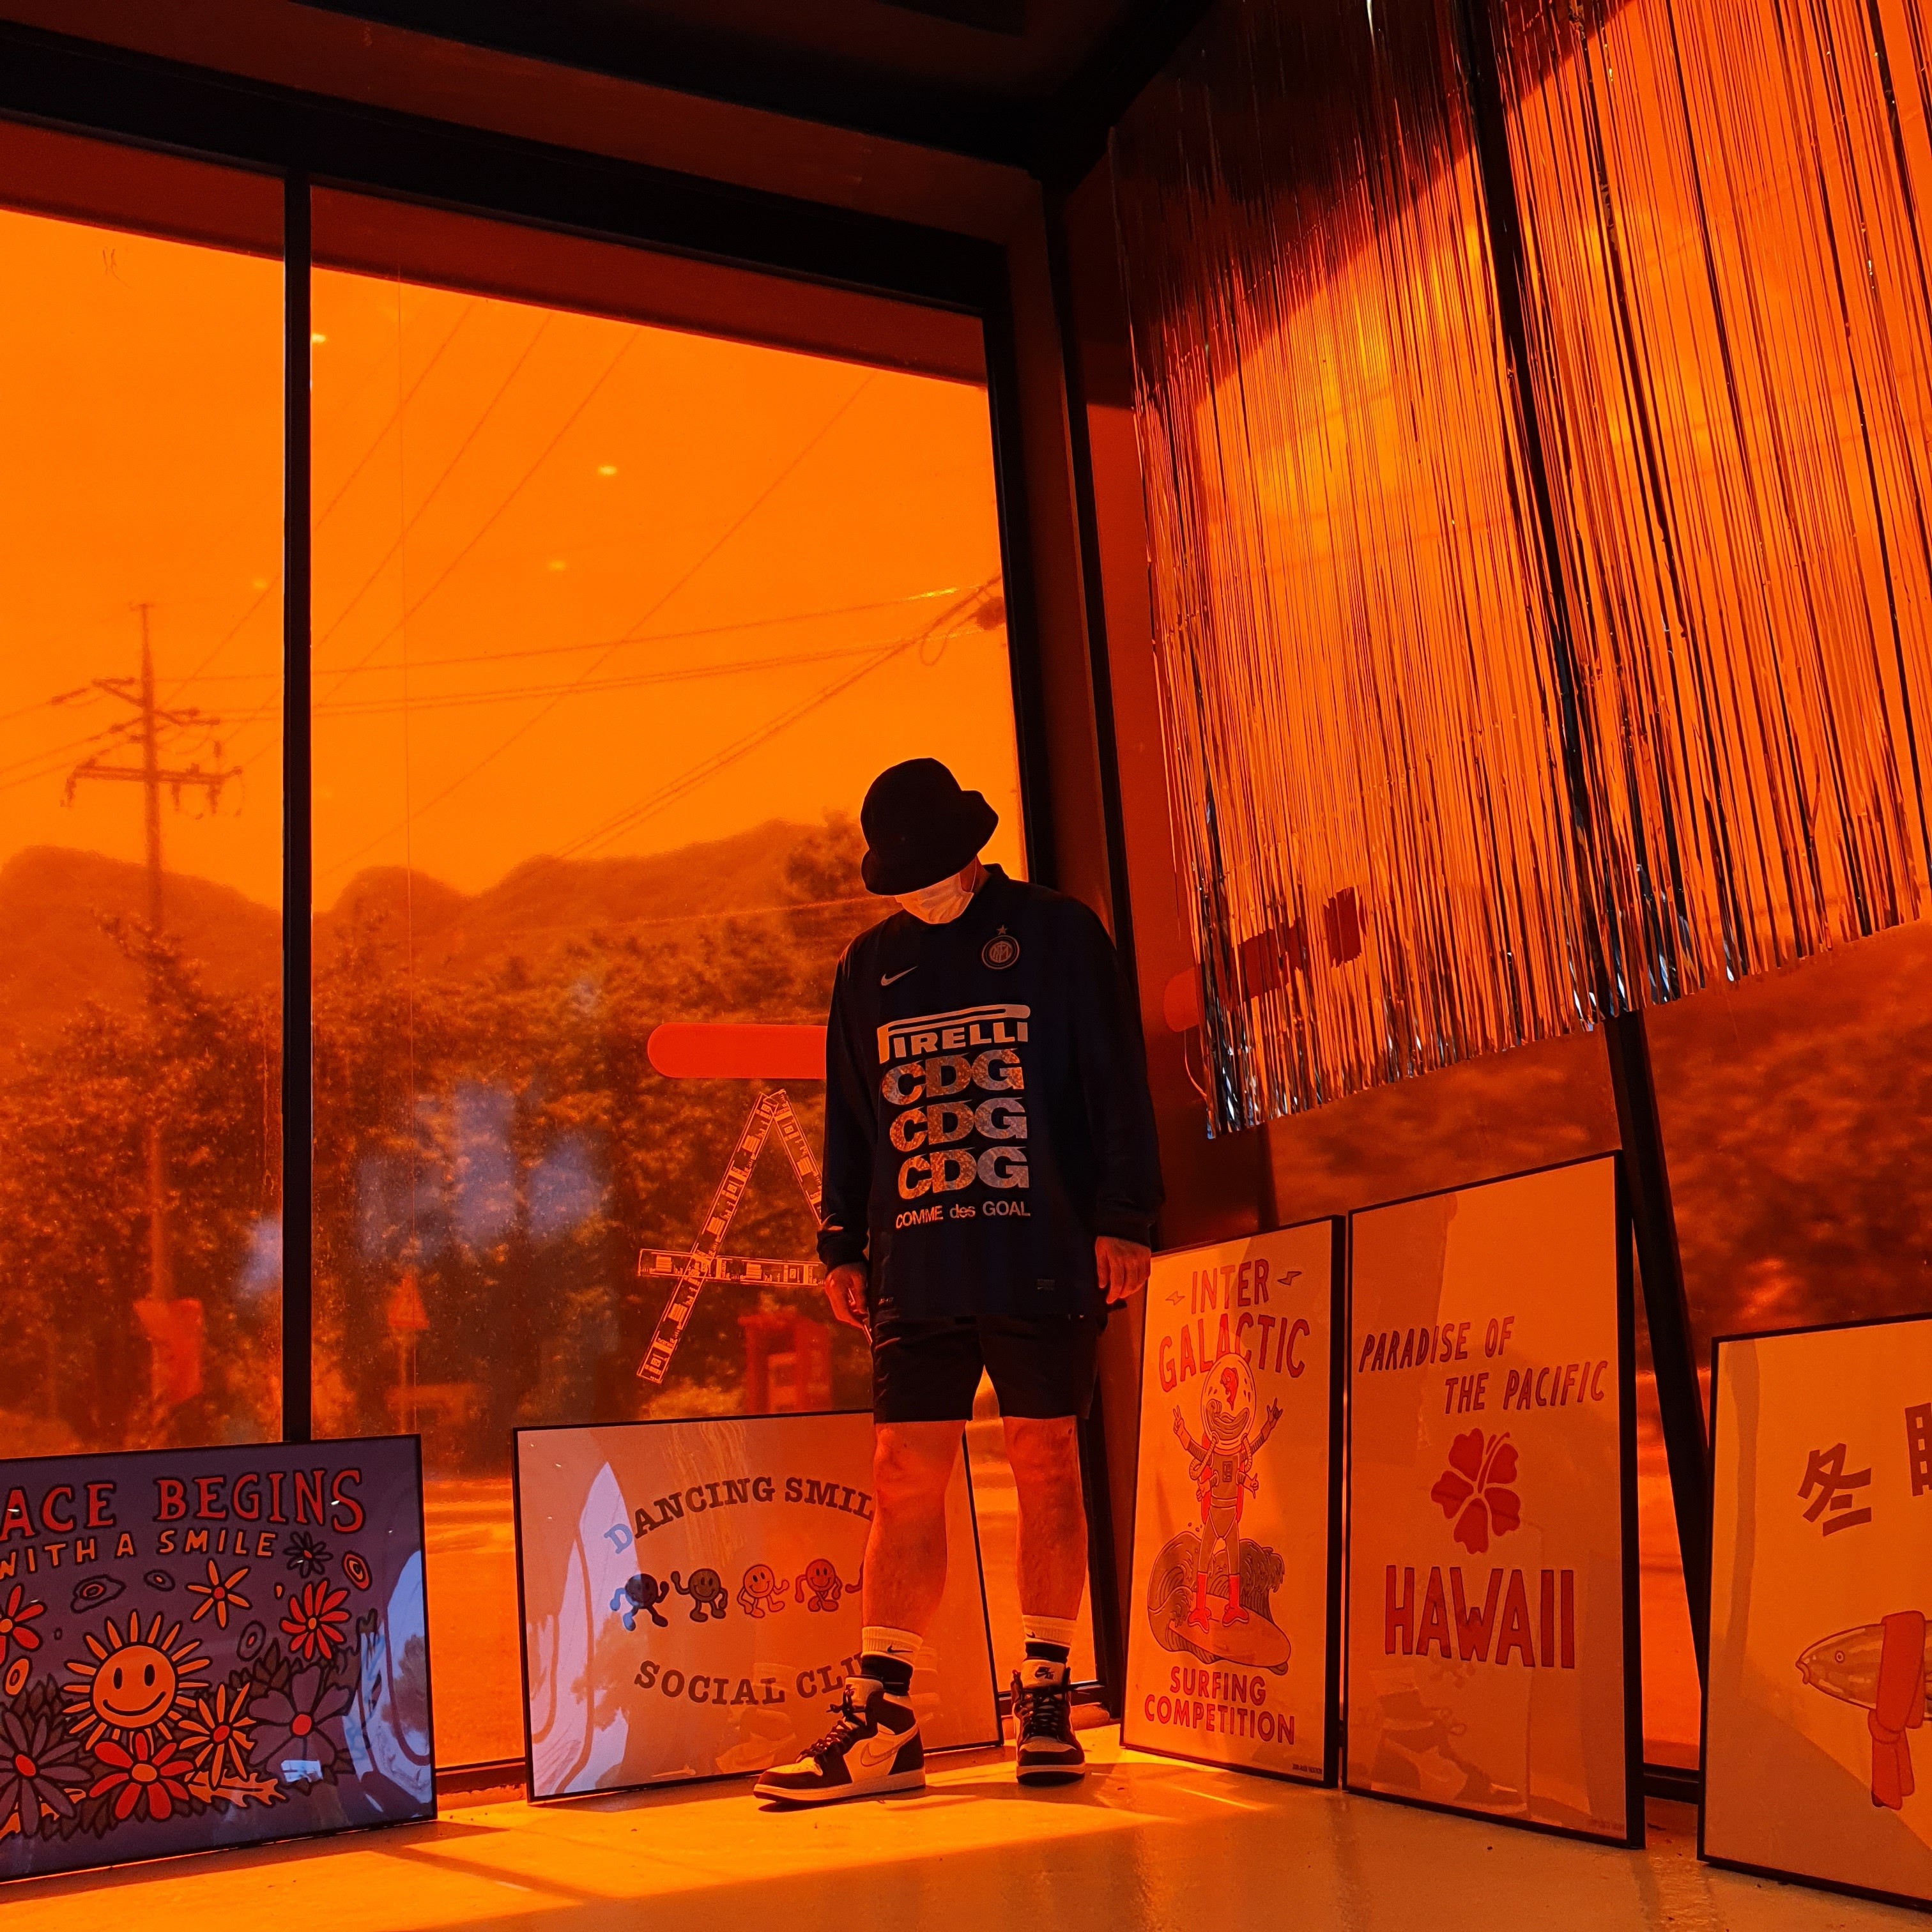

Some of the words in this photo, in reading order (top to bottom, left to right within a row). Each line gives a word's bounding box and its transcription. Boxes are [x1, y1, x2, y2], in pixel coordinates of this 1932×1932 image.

[877, 1004, 1031, 1064] PIRELLI
[882, 1048, 1025, 1105] CDG
[889, 1097, 1028, 1152] CDG
[898, 1146, 1030, 1200] CDG
[896, 1204, 944, 1229] COMME
[949, 1204, 976, 1219] des
[983, 1200, 1031, 1216] GOAL
[1192, 1258, 1269, 1315] INTER
[1158, 1312, 1310, 1393] GALACTIC
[1358, 1321, 1471, 1373] PARADISE
[1484, 1315, 1515, 1358] OF
[1445, 1372, 1489, 1414] THE
[1503, 1360, 1608, 1410] PACIFIC
[0, 1481, 115, 1542] ACE
[153, 1469, 365, 1534] BEGINS
[604, 1476, 776, 1554] DANCING
[785, 1477, 874, 1522] SMIL
[0, 1538, 96, 1580] WITH
[116, 1531, 135, 1558] A
[158, 1528, 277, 1559] SMILE
[1385, 1565, 1575, 1669] HAWAII
[634, 1660, 786, 1705] SOCIAL
[1170, 1666, 1266, 1706] SURFING
[1144, 1694, 1295, 1745] COMPETITION
